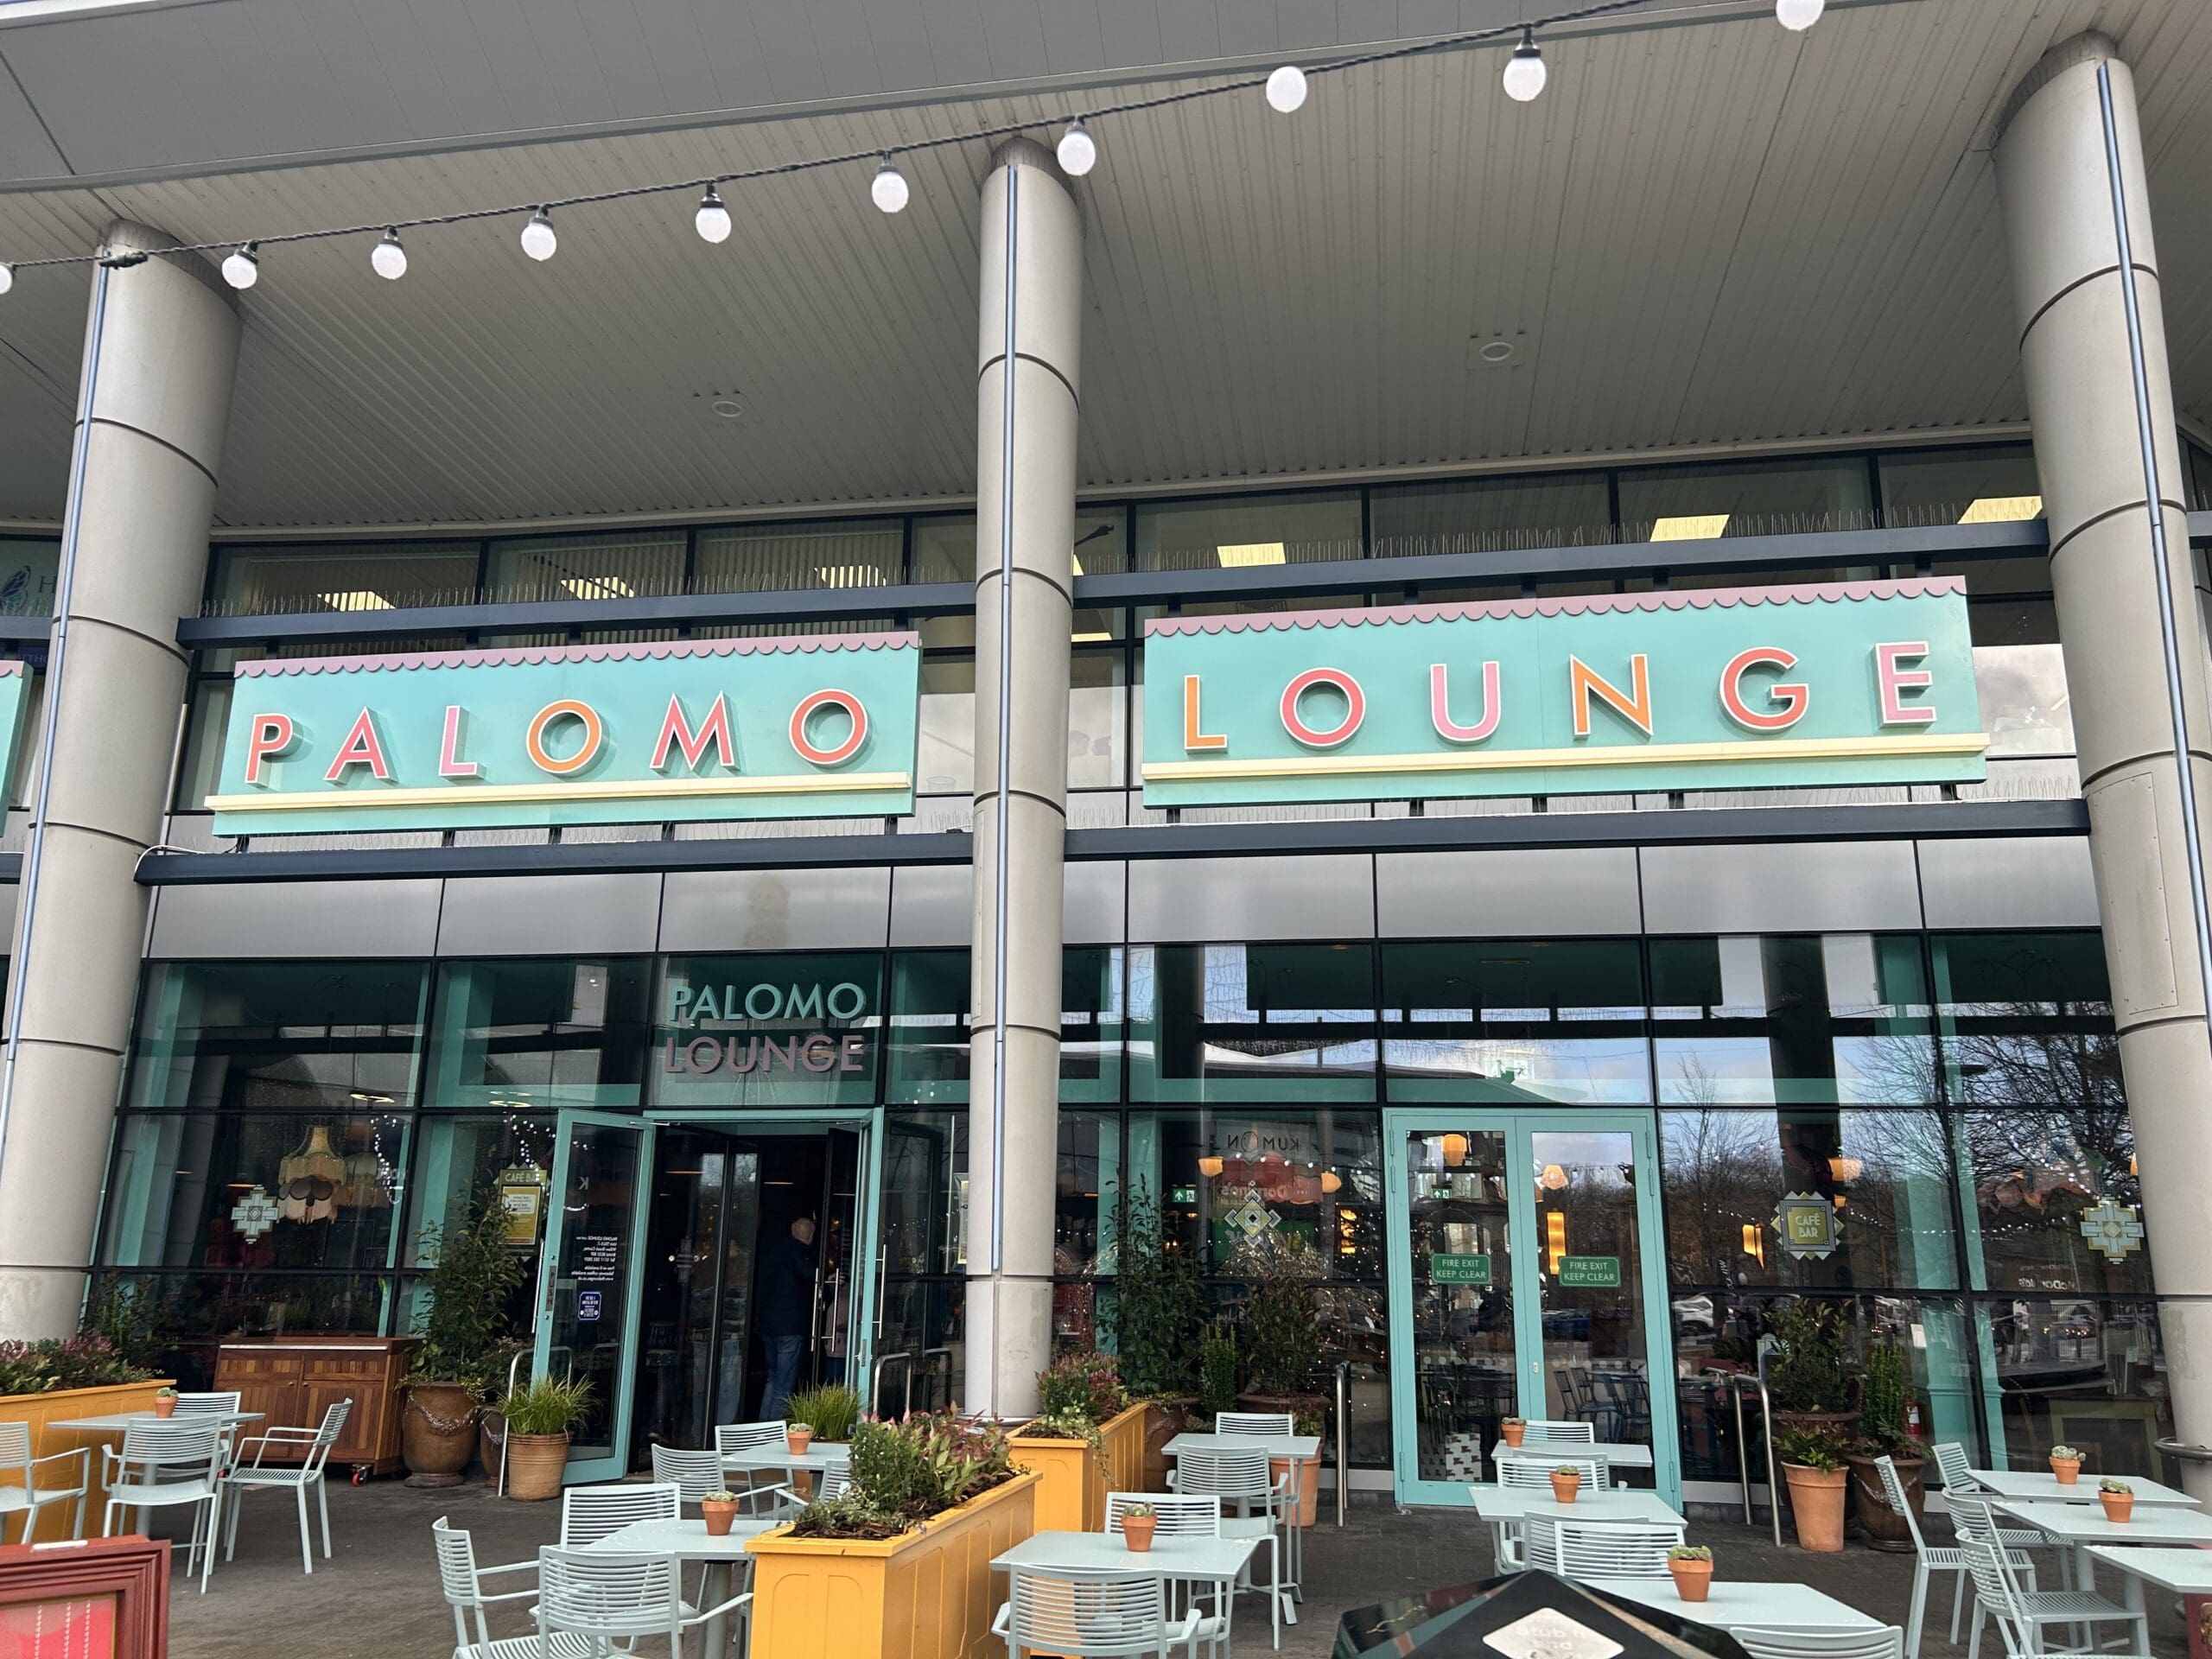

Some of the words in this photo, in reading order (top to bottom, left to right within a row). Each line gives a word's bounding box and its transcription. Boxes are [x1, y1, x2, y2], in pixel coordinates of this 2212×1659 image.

[1183, 639, 1937, 753] LOUNGE
[245, 688, 873, 786] PALOMO
[671, 982, 866, 1021] PALOMO
[664, 1034, 865, 1073] LOUNGE
[1795, 1213, 1821, 1225] CAFÉ
[1798, 1227, 1818, 1237] BAR
[1442, 1259, 1459, 1268] FIRE
[1461, 1259, 1479, 1268] EXIT
[1569, 1262, 1587, 1270] FIRE
[1436, 1269, 1457, 1278] KEEP
[1459, 1270, 1486, 1279] CLEAR
